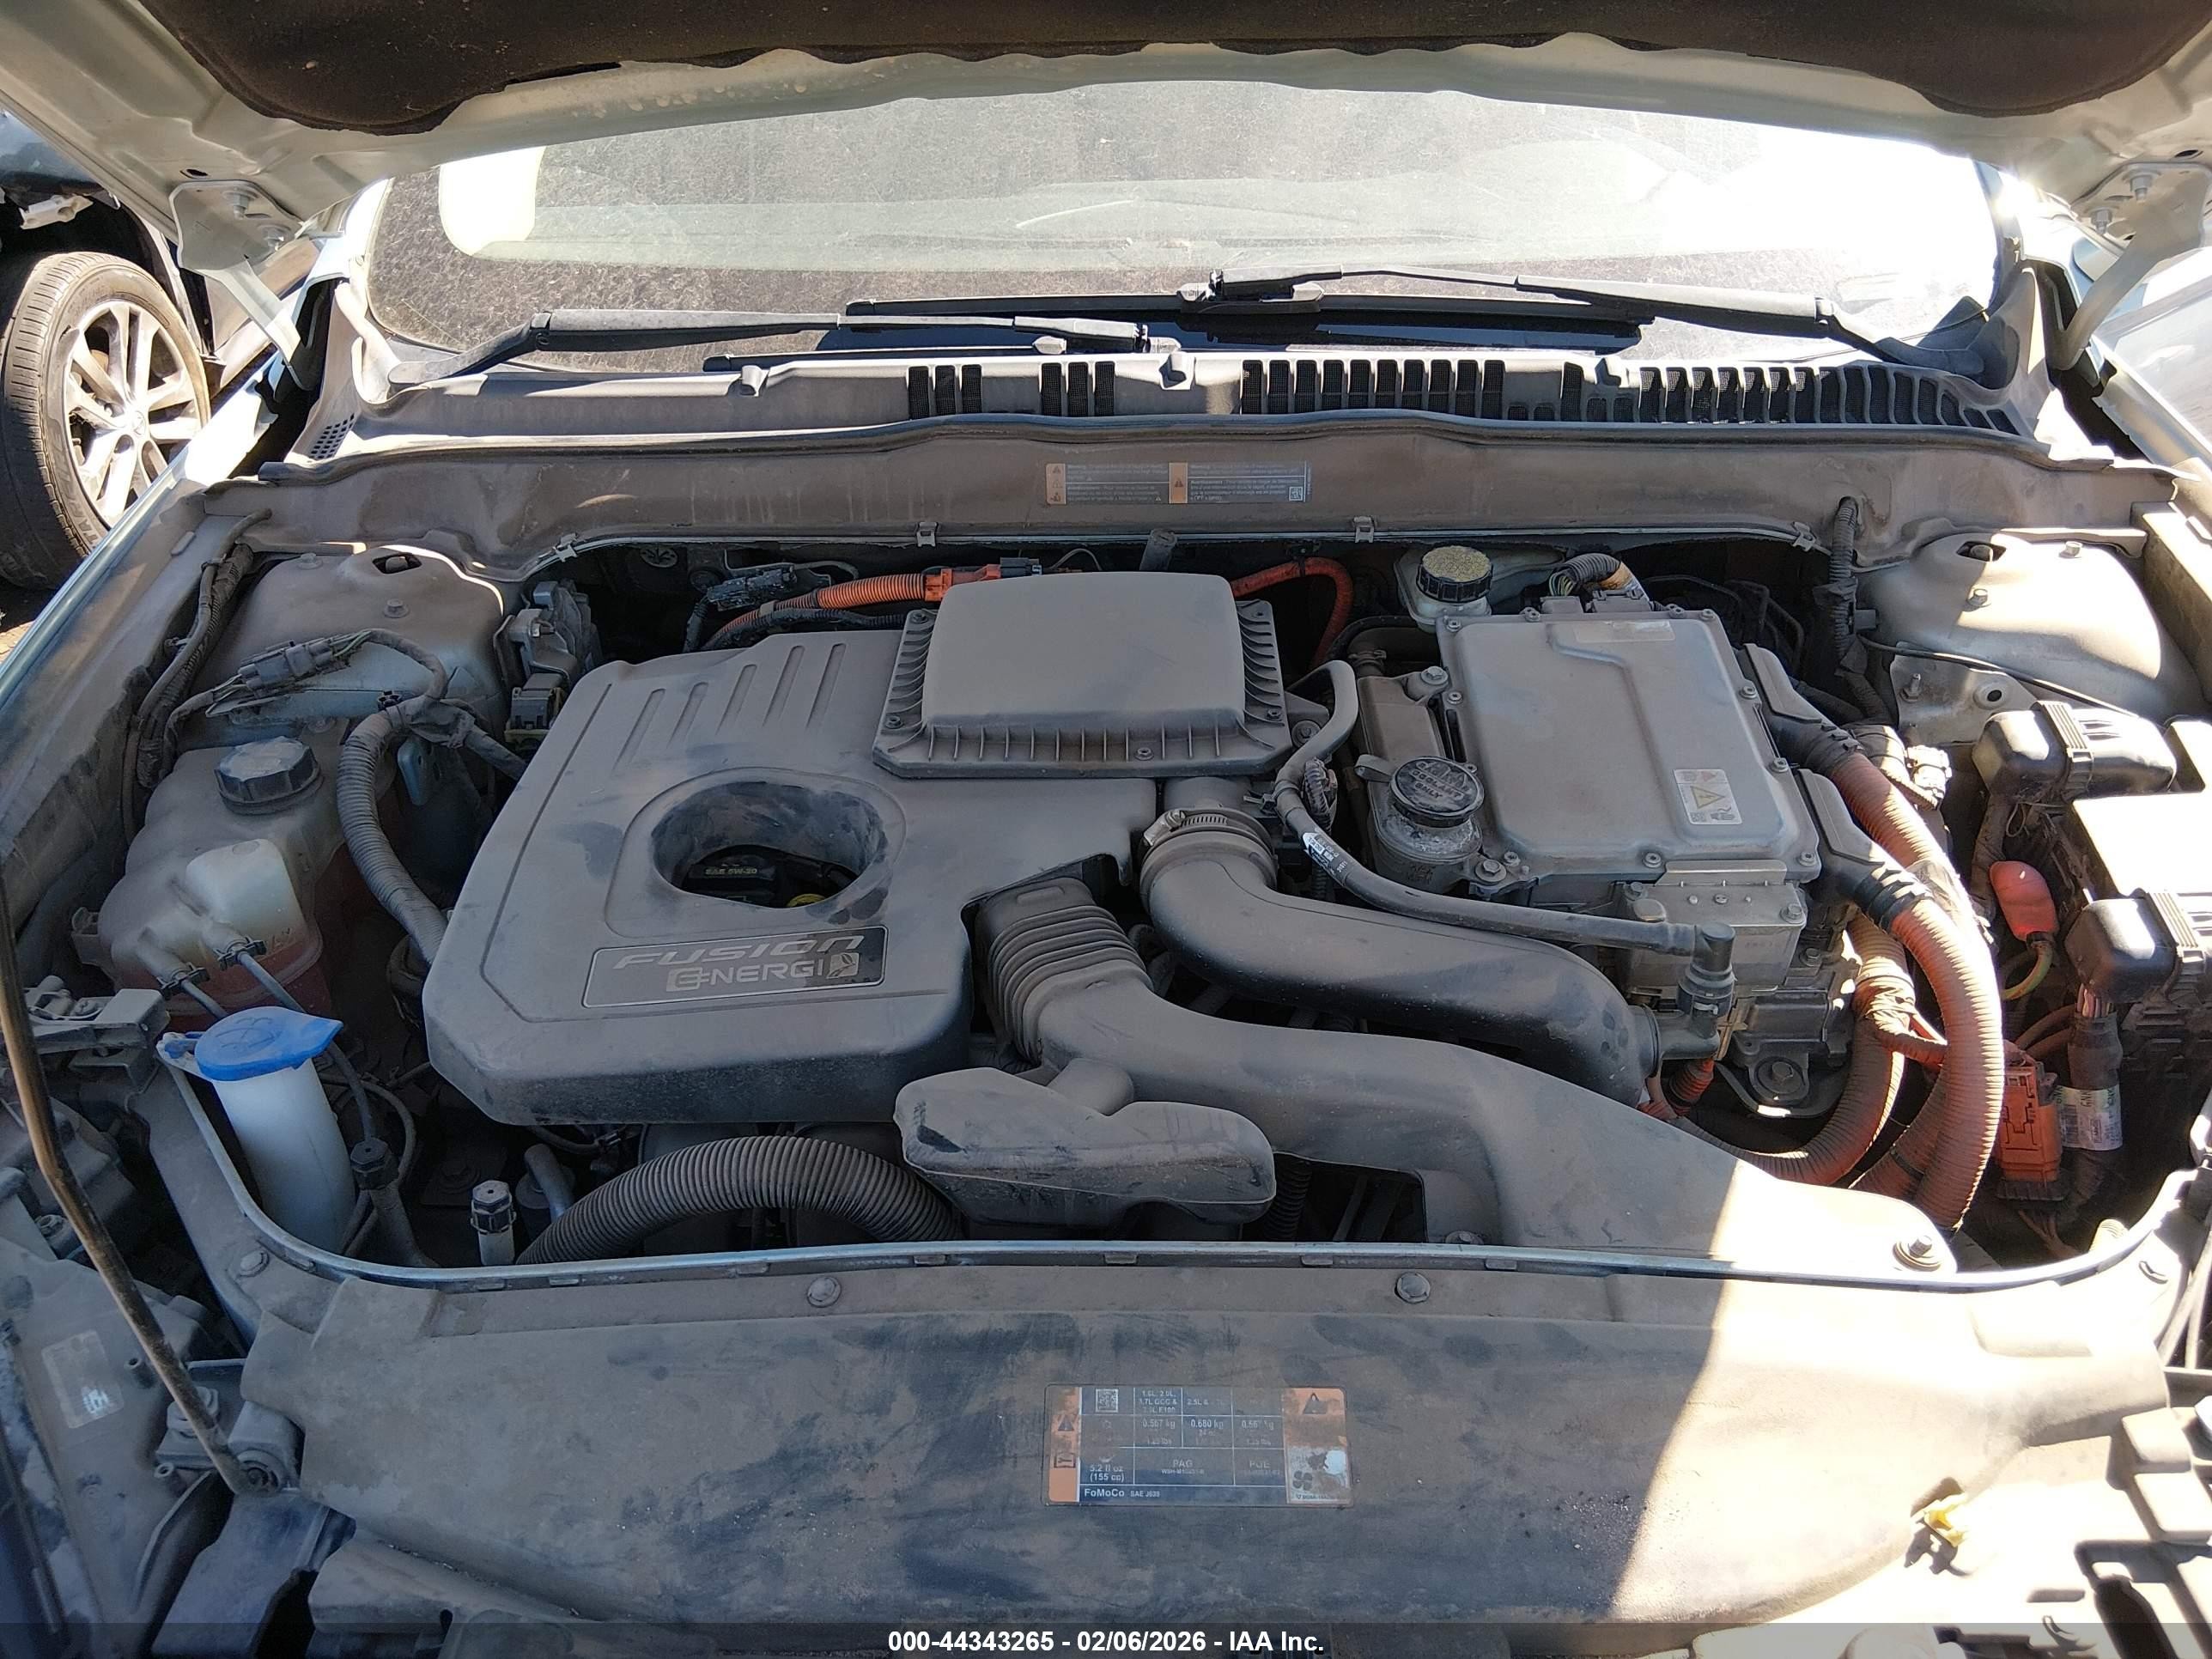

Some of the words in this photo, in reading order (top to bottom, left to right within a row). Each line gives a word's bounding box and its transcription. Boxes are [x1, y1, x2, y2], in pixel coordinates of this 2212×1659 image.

[1414, 781, 1443, 799] ONLY
[612, 934, 866, 969] FUSION
[1190, 1419, 1212, 1428] 0.680
[1173, 1459, 1193, 1468] PAG
[1090, 1473, 1109, 1482] (155
[1110, 1473, 1125, 1482] cc)
[1085, 1488, 1125, 1498] FoMoCo
